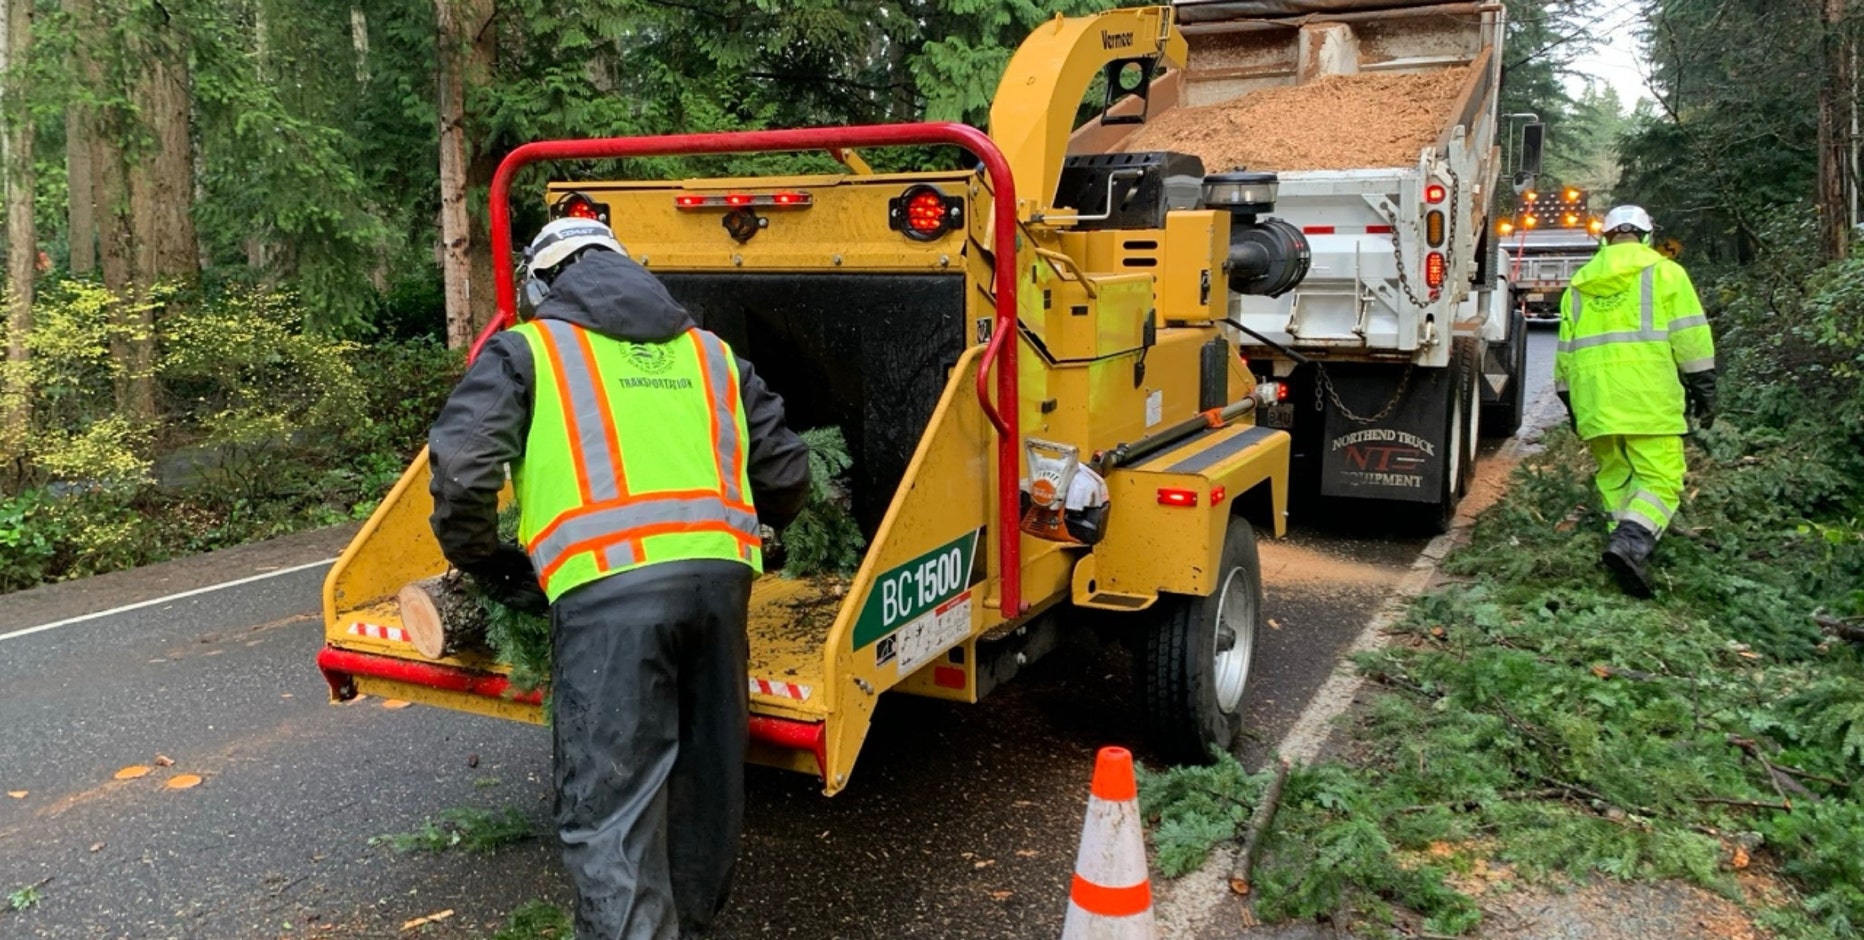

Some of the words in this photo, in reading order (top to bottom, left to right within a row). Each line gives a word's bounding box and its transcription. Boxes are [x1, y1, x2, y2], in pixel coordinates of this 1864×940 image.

[1101, 30, 1133, 50] Vermeer
[619, 377, 693, 390] TRANSPORTATION
[1332, 429, 1395, 451] NORTHEND
[1398, 432, 1435, 456] TRUCK
